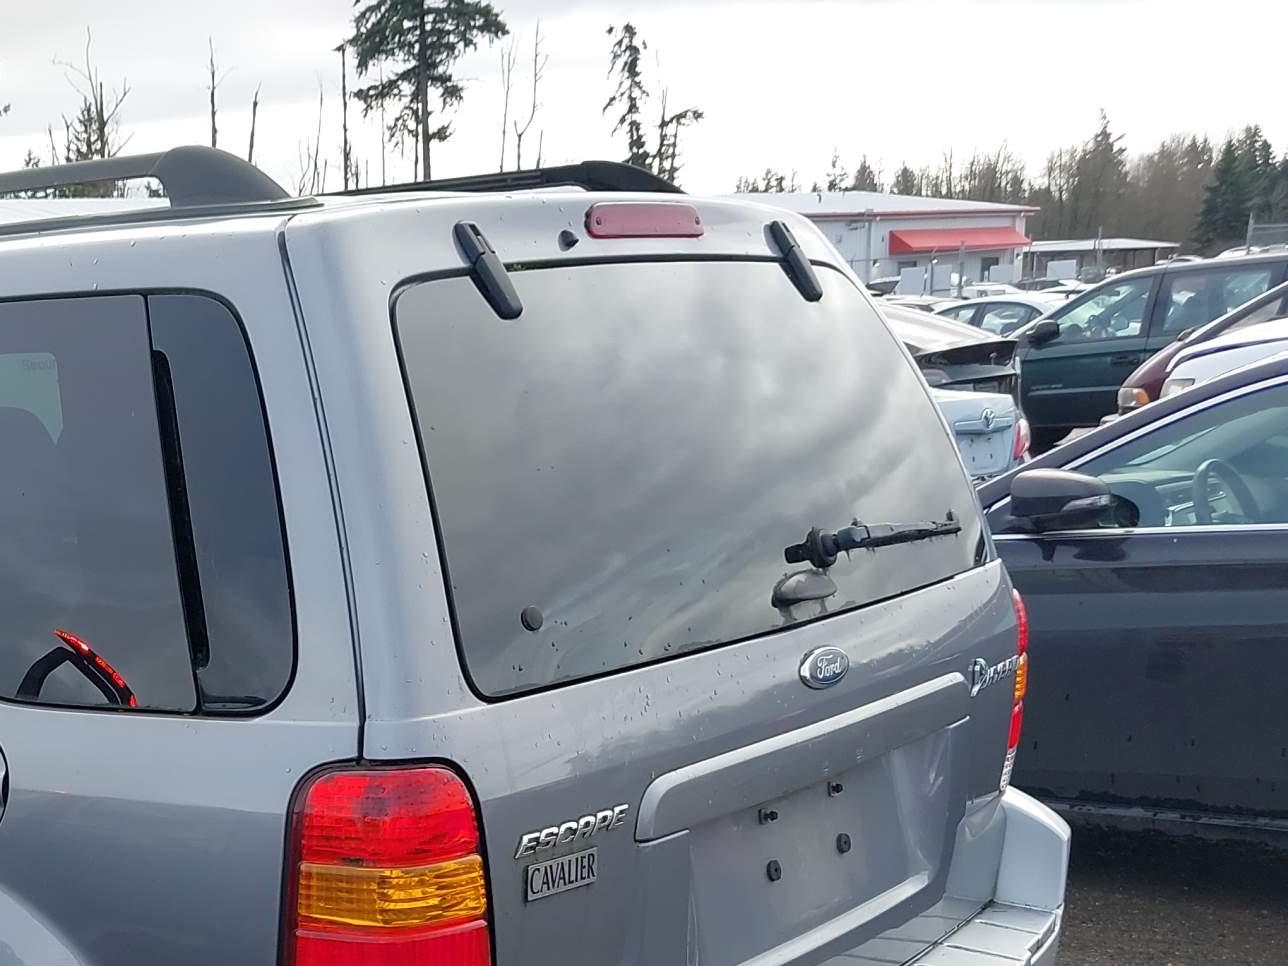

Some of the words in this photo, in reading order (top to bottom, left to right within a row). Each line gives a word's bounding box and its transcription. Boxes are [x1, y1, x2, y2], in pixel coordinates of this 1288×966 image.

[816, 654, 842, 679] Ford
[514, 803, 630, 860] ESCAPE
[529, 852, 596, 896] CAVALIER
